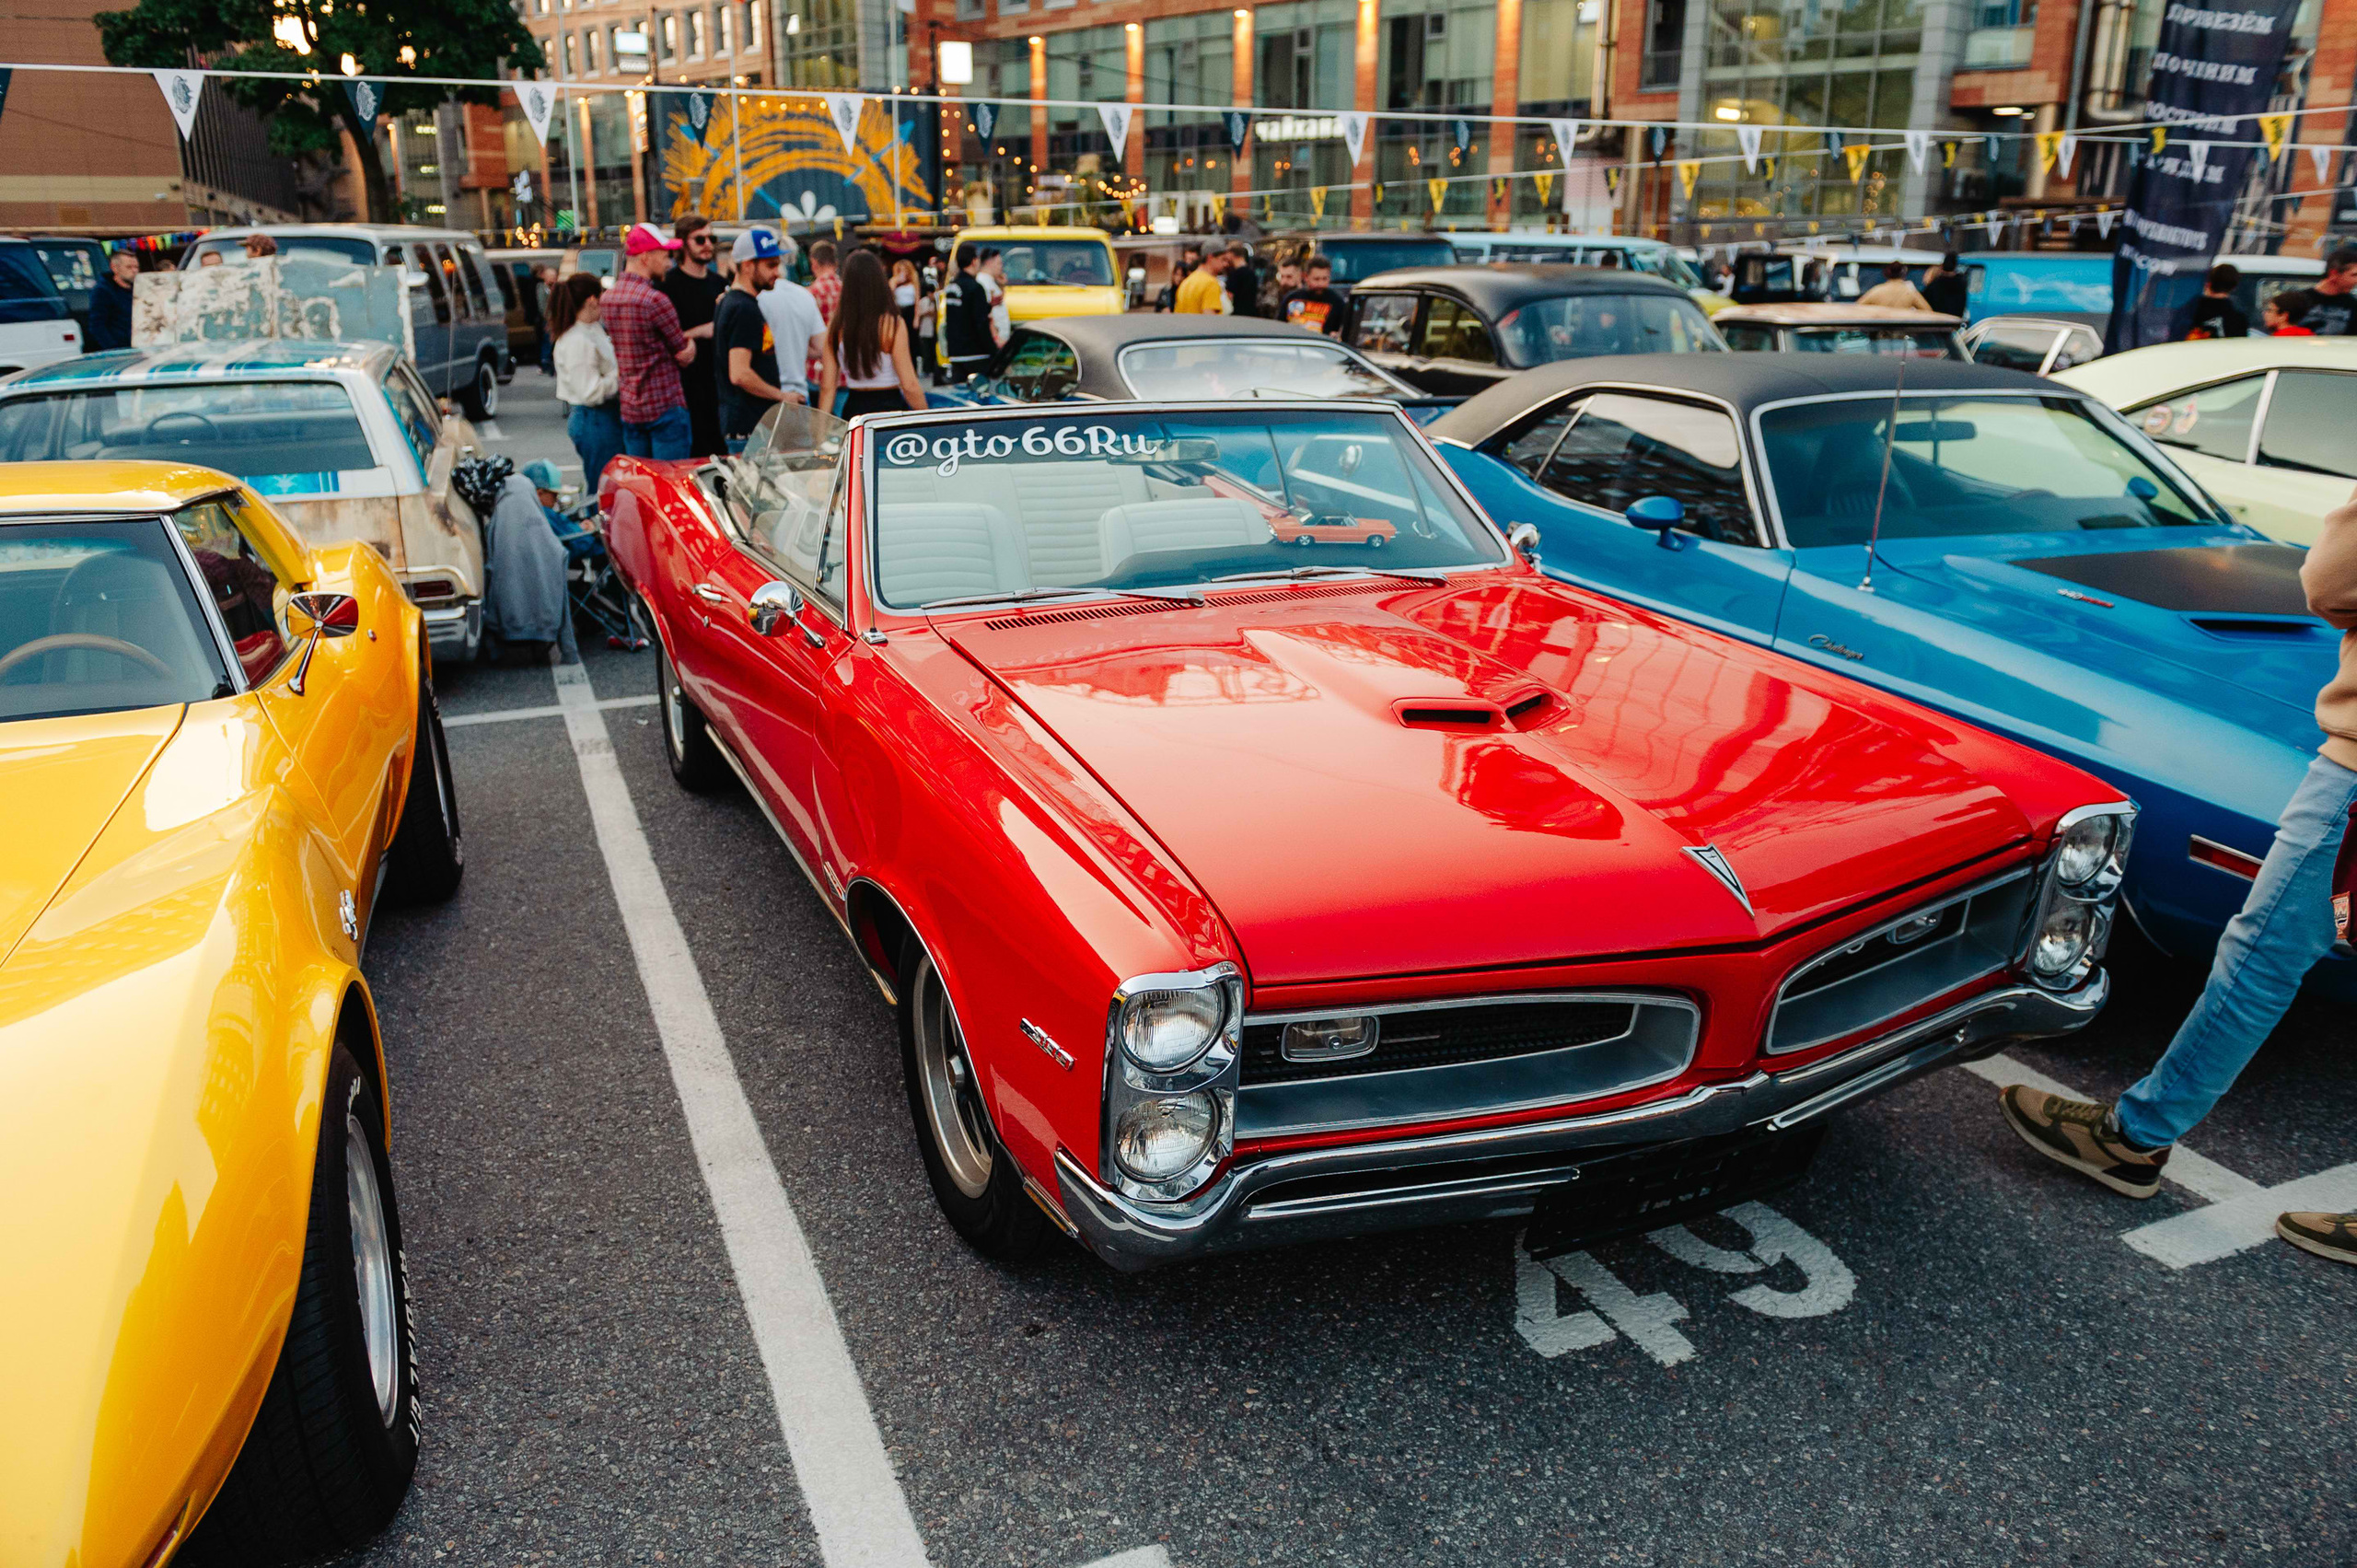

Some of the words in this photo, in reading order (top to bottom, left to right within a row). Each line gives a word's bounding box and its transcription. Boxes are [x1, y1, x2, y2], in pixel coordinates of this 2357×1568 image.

[886, 425, 1158, 477] @gto66Ru
[399, 1249, 419, 1386] RADIAL
[1515, 1200, 1859, 1368] 49
